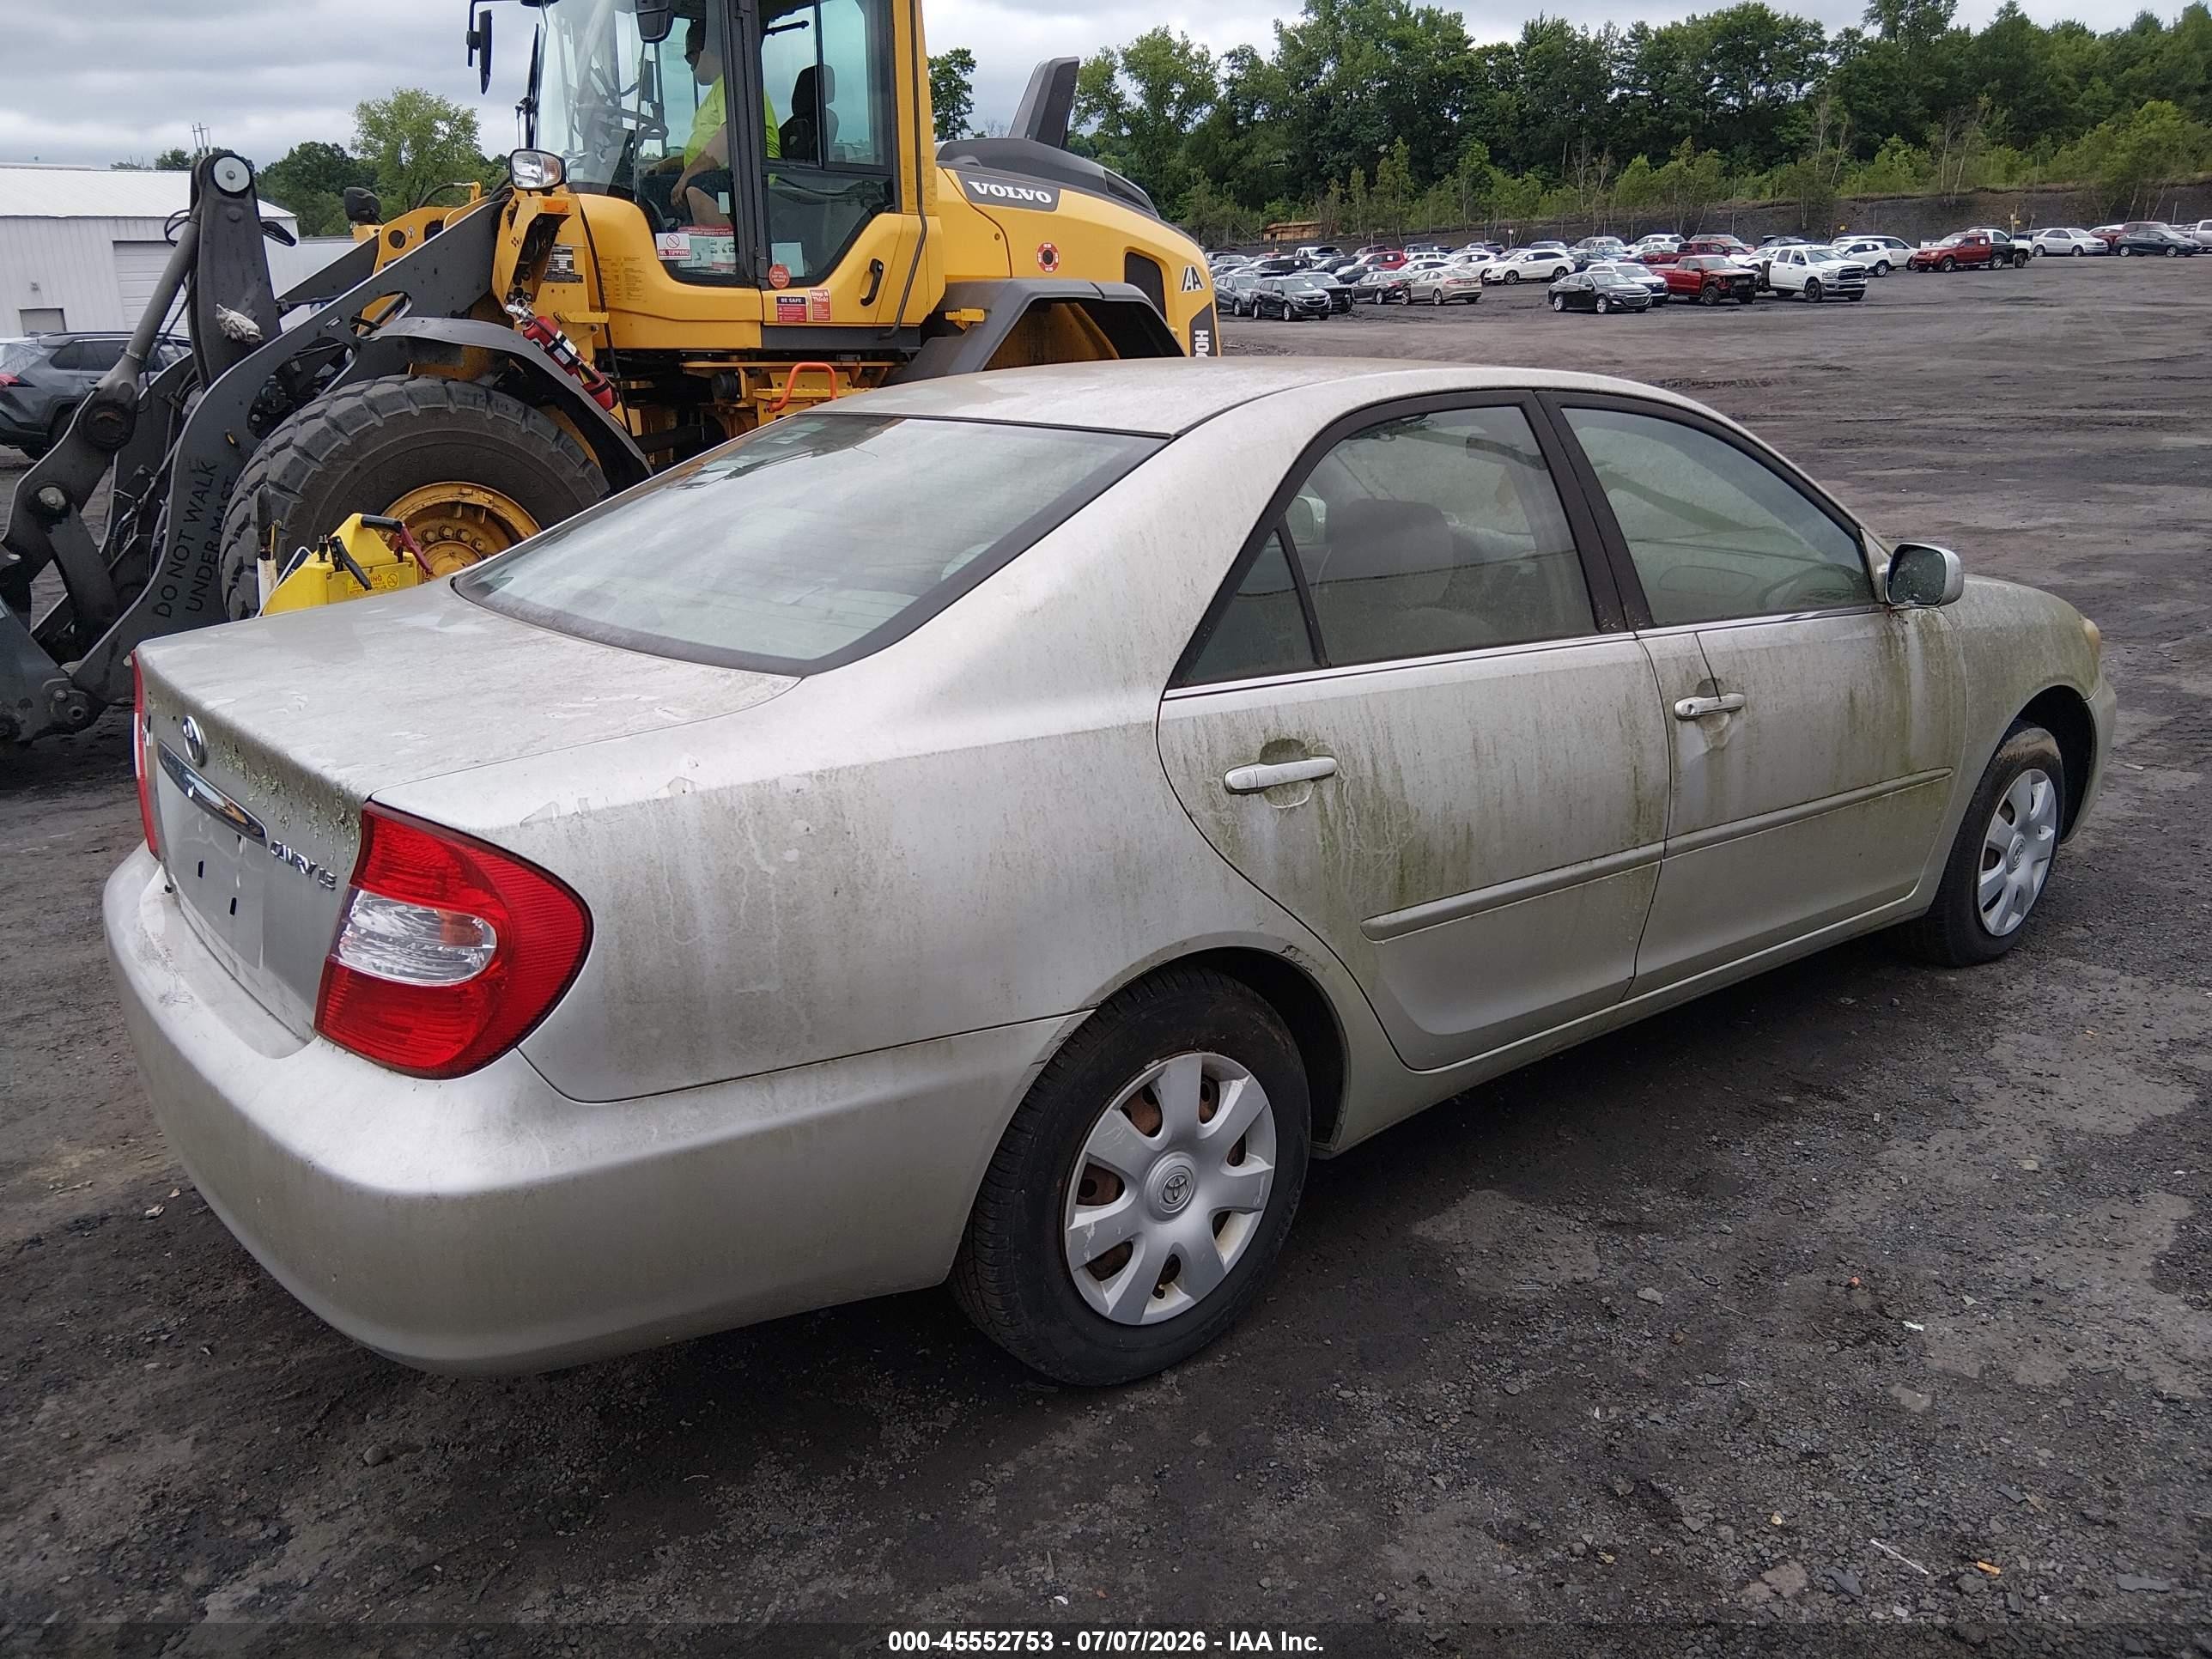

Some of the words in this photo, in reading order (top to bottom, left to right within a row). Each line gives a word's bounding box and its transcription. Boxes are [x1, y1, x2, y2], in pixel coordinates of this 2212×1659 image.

[968, 180, 1052, 204] VOLVO
[152, 584, 178, 618] DO
[167, 529, 196, 580] NOT
[183, 459, 218, 524] WALK
[185, 541, 219, 613] UNDER
[352, 574, 382, 585] WING
[318, 867, 337, 890] LE
